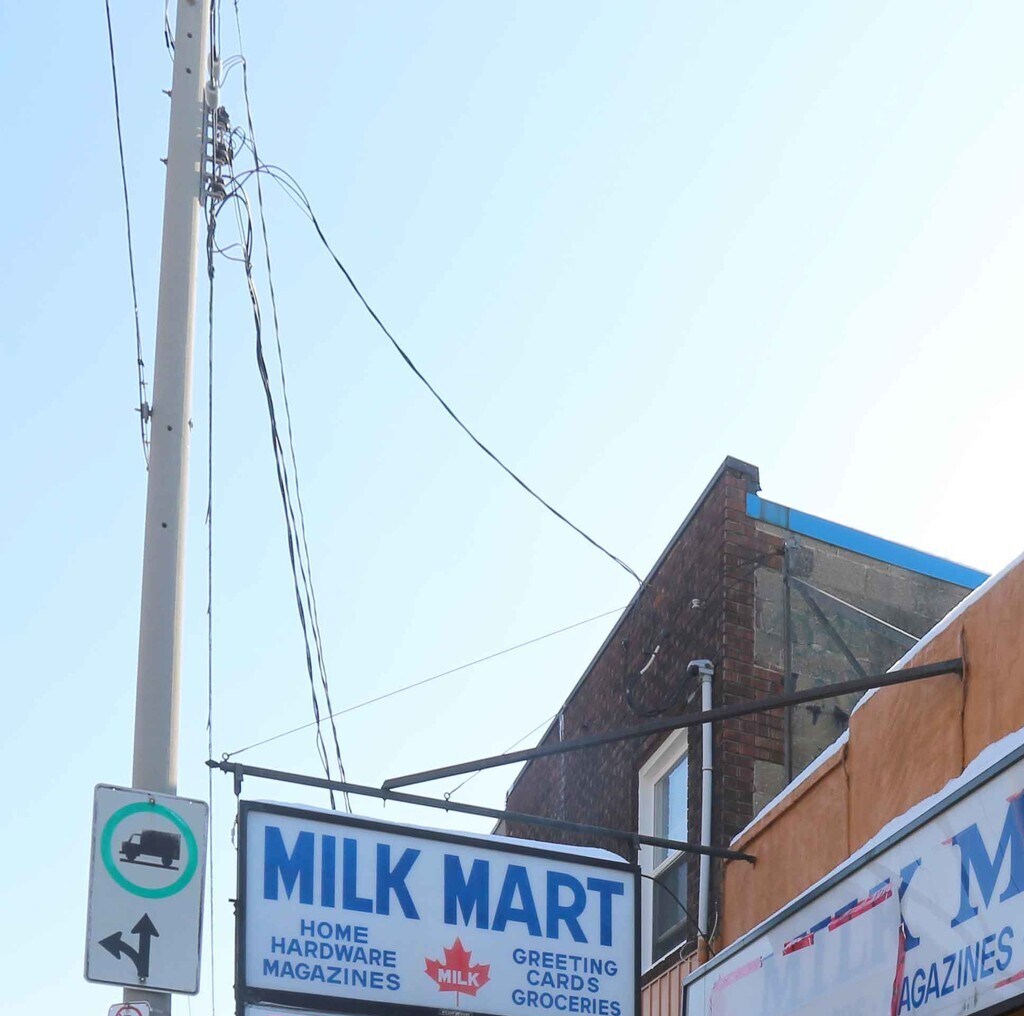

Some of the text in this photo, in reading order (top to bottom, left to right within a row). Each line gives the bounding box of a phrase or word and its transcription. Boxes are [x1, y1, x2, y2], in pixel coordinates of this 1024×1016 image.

[263, 825, 624, 947] MILK MART
[300, 918, 369, 944] HOME
[271, 936, 397, 968] HARDWARE
[512, 948, 618, 977] GREETING
[263, 958, 400, 991] MAGAZINES
[438, 966, 480, 988] MILK
[526, 970, 600, 993] CARDS
[897, 924, 1013, 1016] AGAZINES
[511, 989, 622, 1016] GROCERIES
